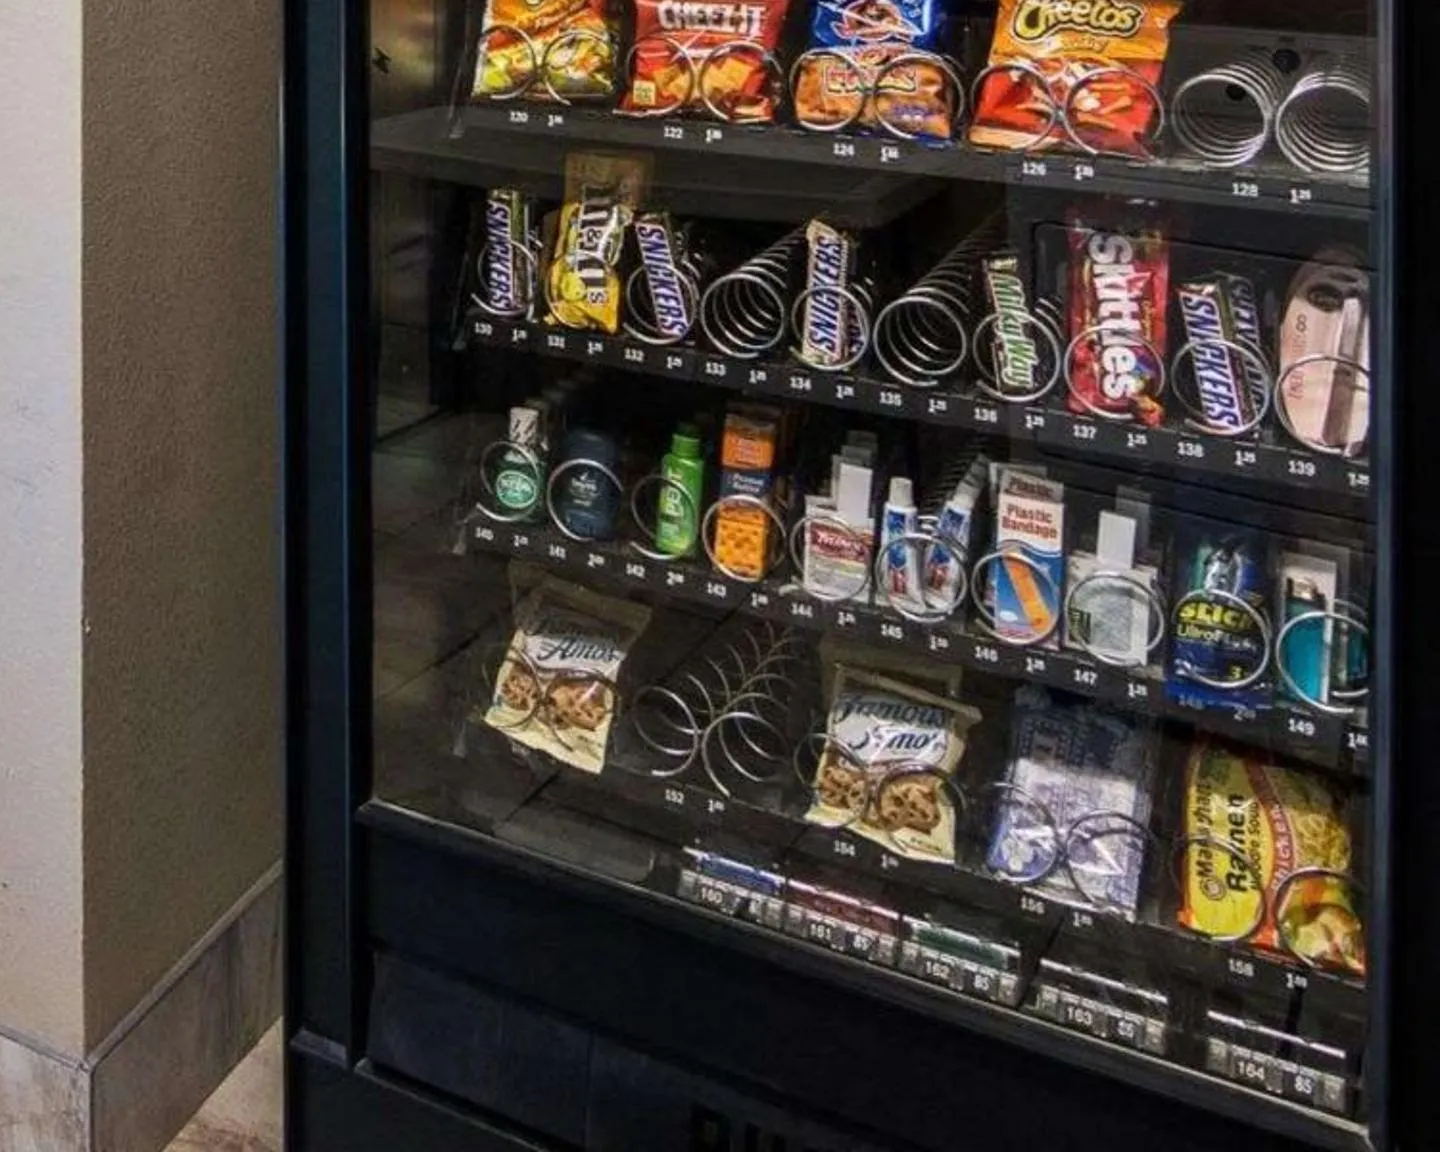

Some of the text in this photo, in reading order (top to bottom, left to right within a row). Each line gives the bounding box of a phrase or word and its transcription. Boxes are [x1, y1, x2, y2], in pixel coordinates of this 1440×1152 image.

[1231, 182, 1258, 198] 128
[486, 200, 513, 311] SNICKERS
[636, 223, 689, 338] SNICKERS
[809, 235, 843, 354] SNICKERS
[1087, 232, 1145, 399] Skittles
[1182, 294, 1241, 430] SNICKERS
[1073, 424, 1097, 440] 137
[1287, 459, 1317, 478] 139
[1006, 502, 1053, 525] Plastic
[1000, 516, 1058, 541] Bandage
[1073, 668, 1098, 687] 147
[1287, 717, 1317, 738] 149
[1224, 792, 1248, 892] Ramen
[1236, 1060, 1265, 1081] 164
